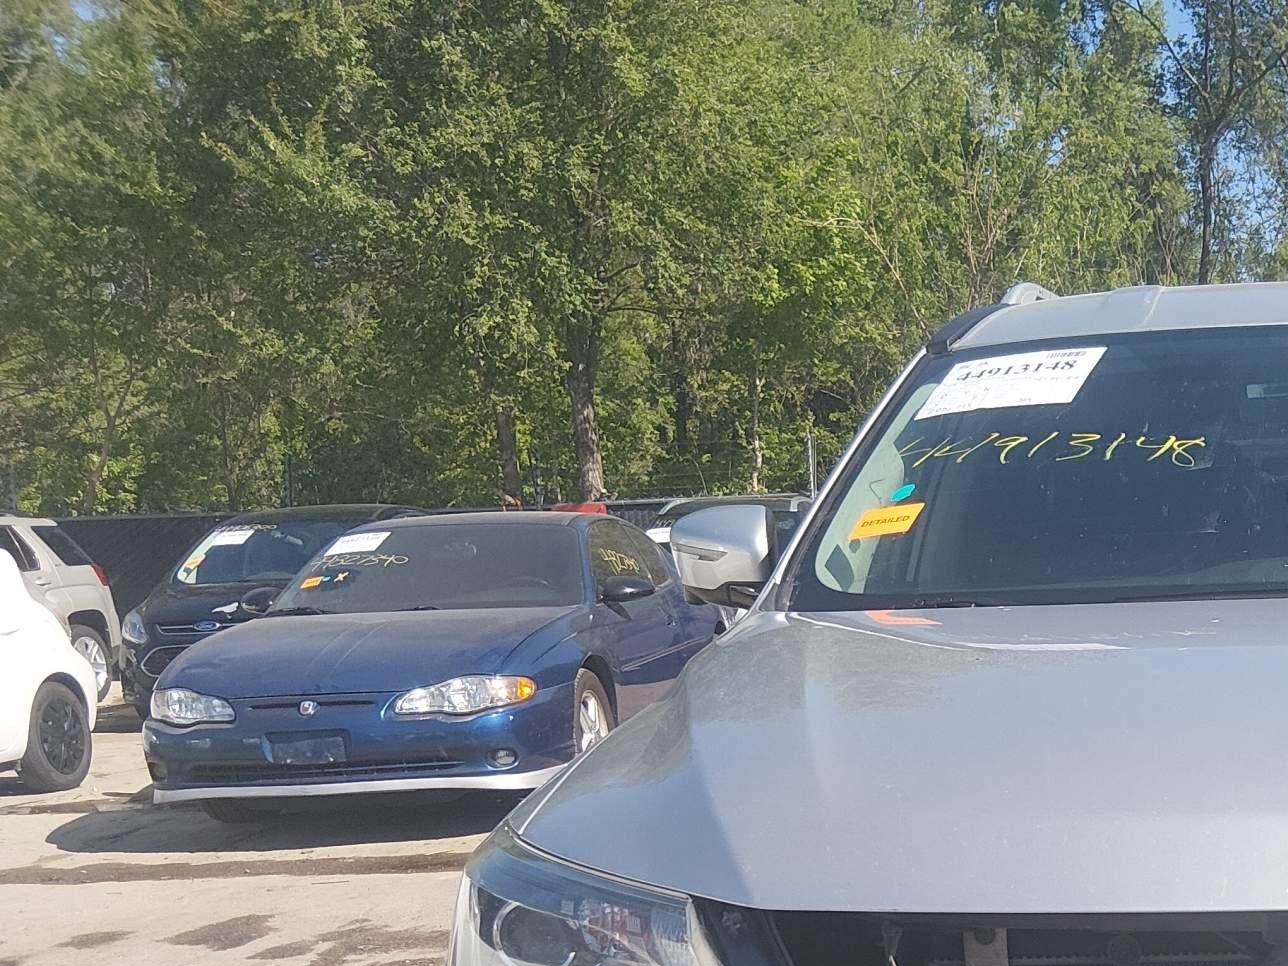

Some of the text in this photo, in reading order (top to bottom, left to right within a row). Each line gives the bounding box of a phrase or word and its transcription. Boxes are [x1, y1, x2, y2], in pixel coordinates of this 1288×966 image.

[956, 360, 1077, 382] 44913148
[900, 432, 1206, 468] 44913148
[860, 515, 910, 528] DETAILED
